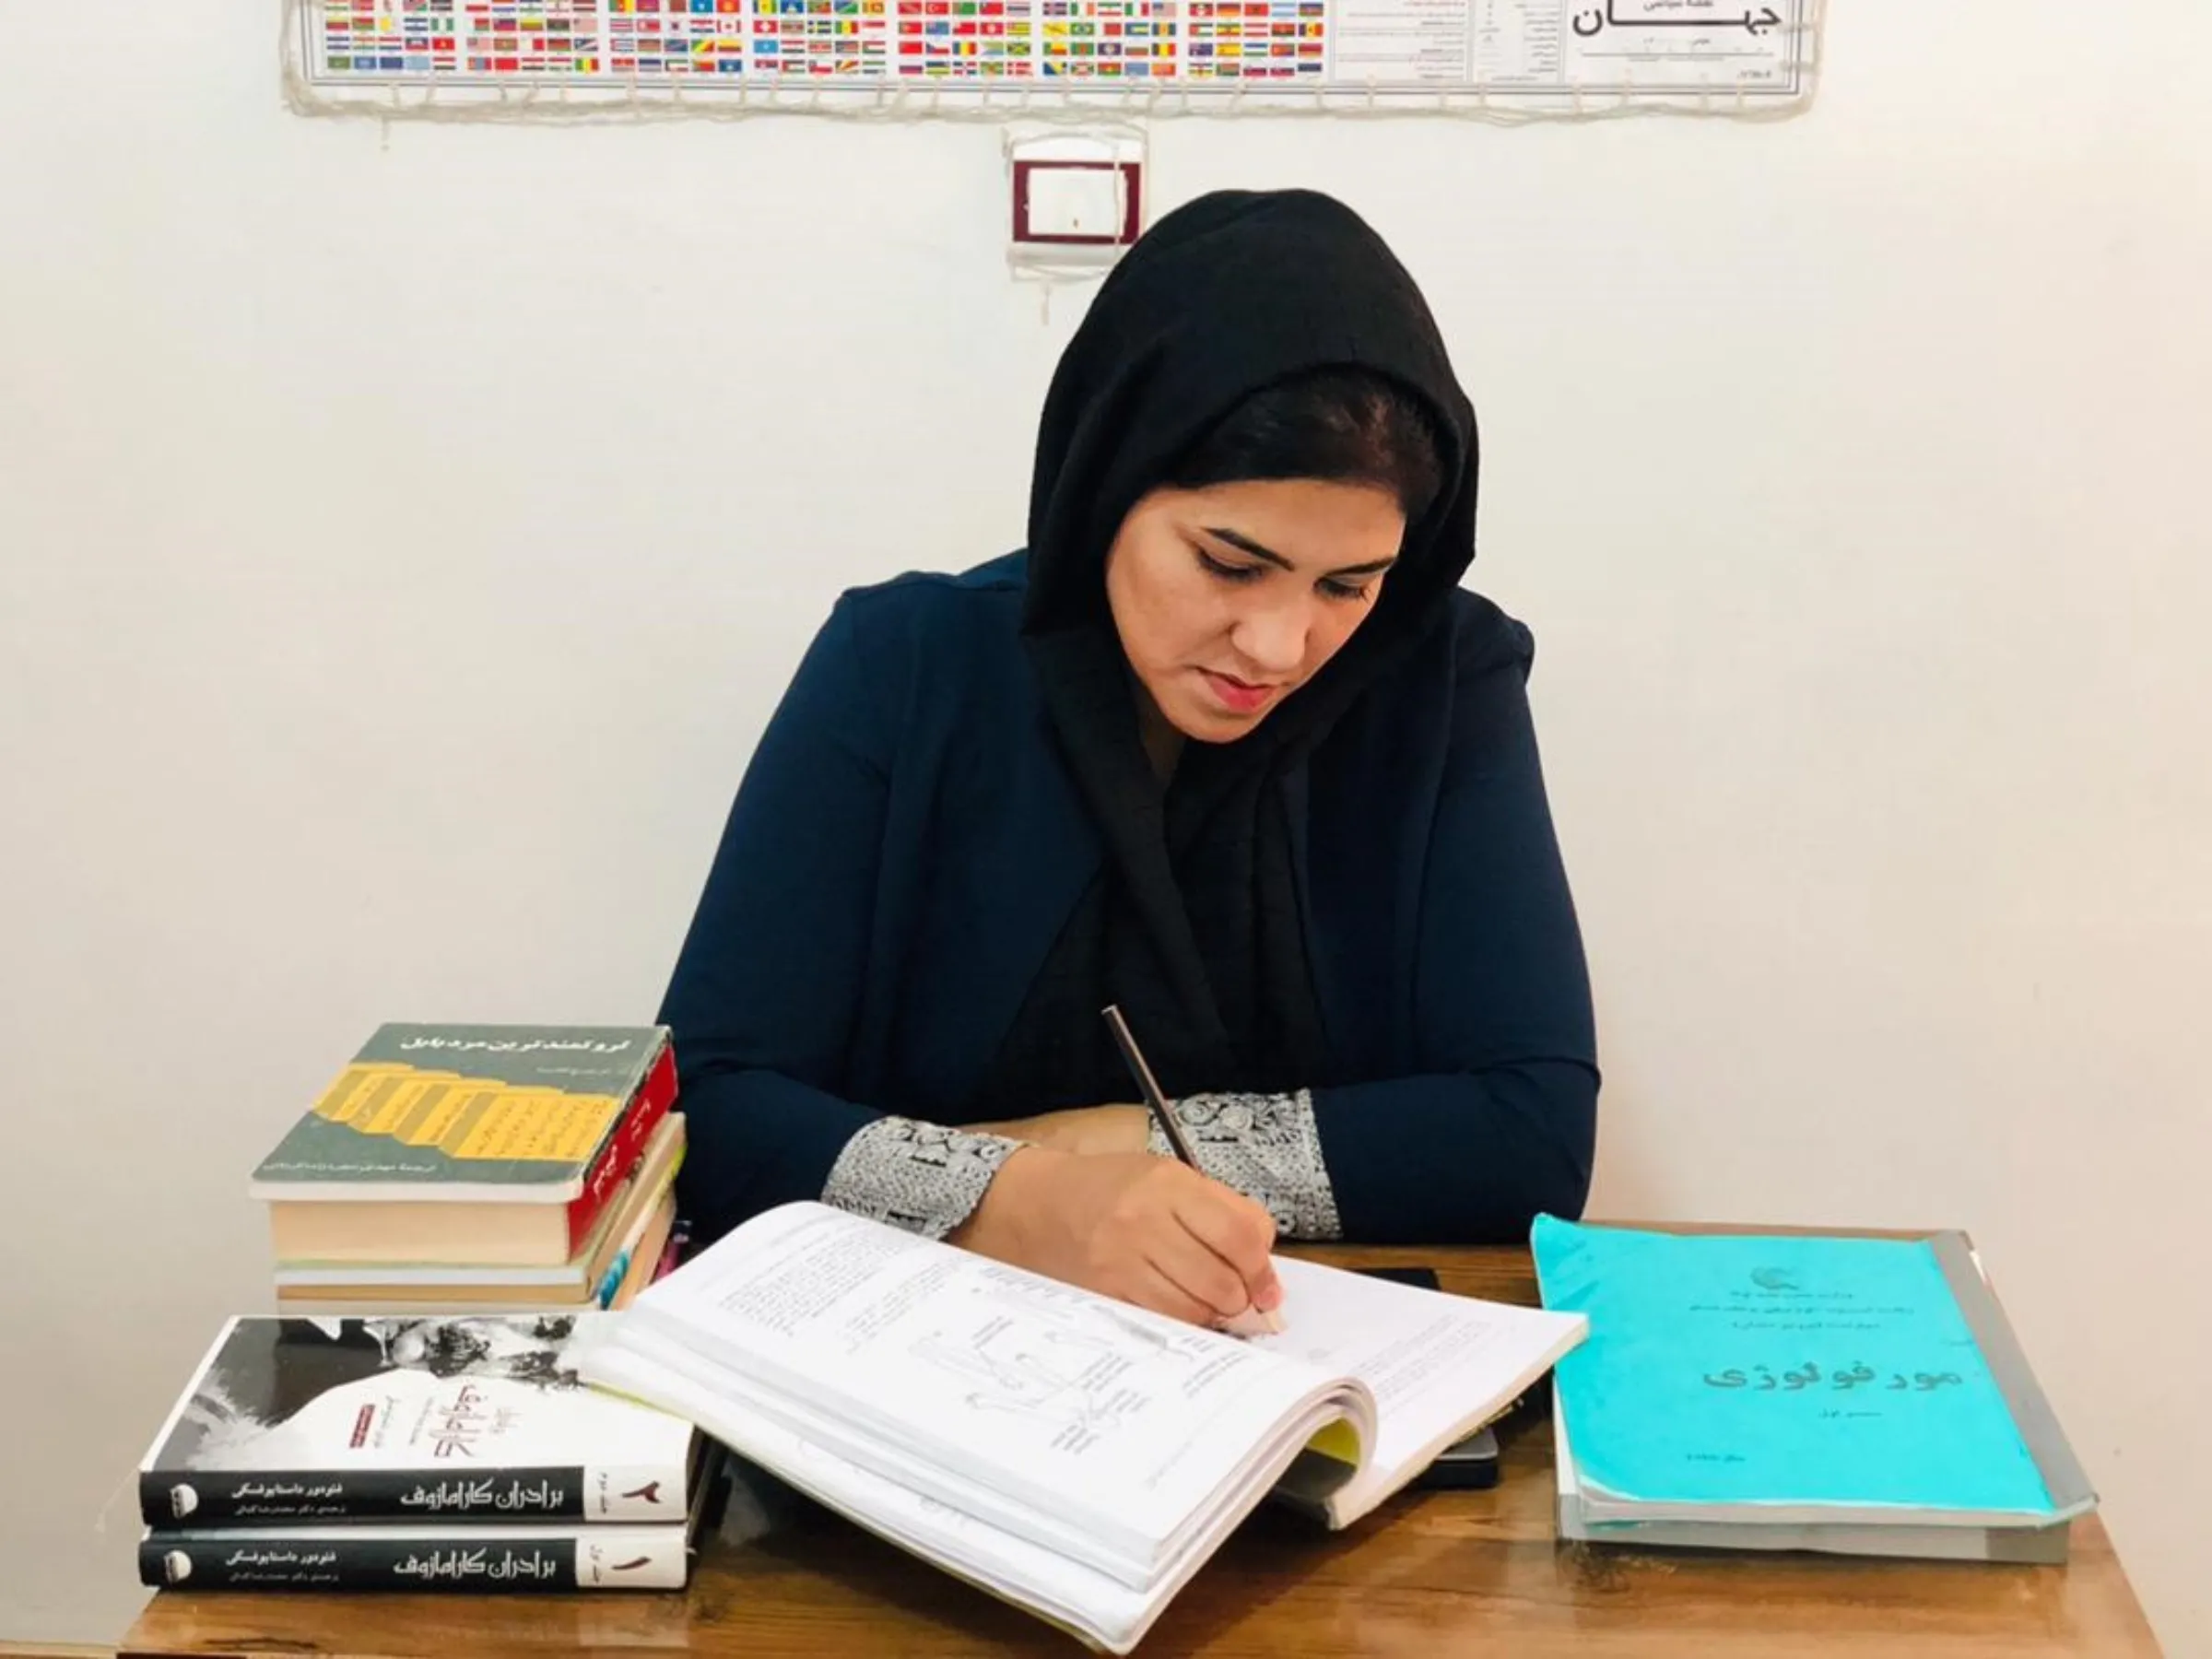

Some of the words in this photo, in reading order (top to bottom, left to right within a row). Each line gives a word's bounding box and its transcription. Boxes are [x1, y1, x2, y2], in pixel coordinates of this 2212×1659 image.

[1572, 0, 1781, 37] جهان
[400, 1037, 446, 1050] بابل
[447, 1040, 488, 1052] مرد
[400, 1477, 494, 1510] کارامازوف
[495, 1479, 564, 1510] برادران
[393, 1547, 487, 1579] کارامازوف
[488, 1549, 556, 1579] برادران
